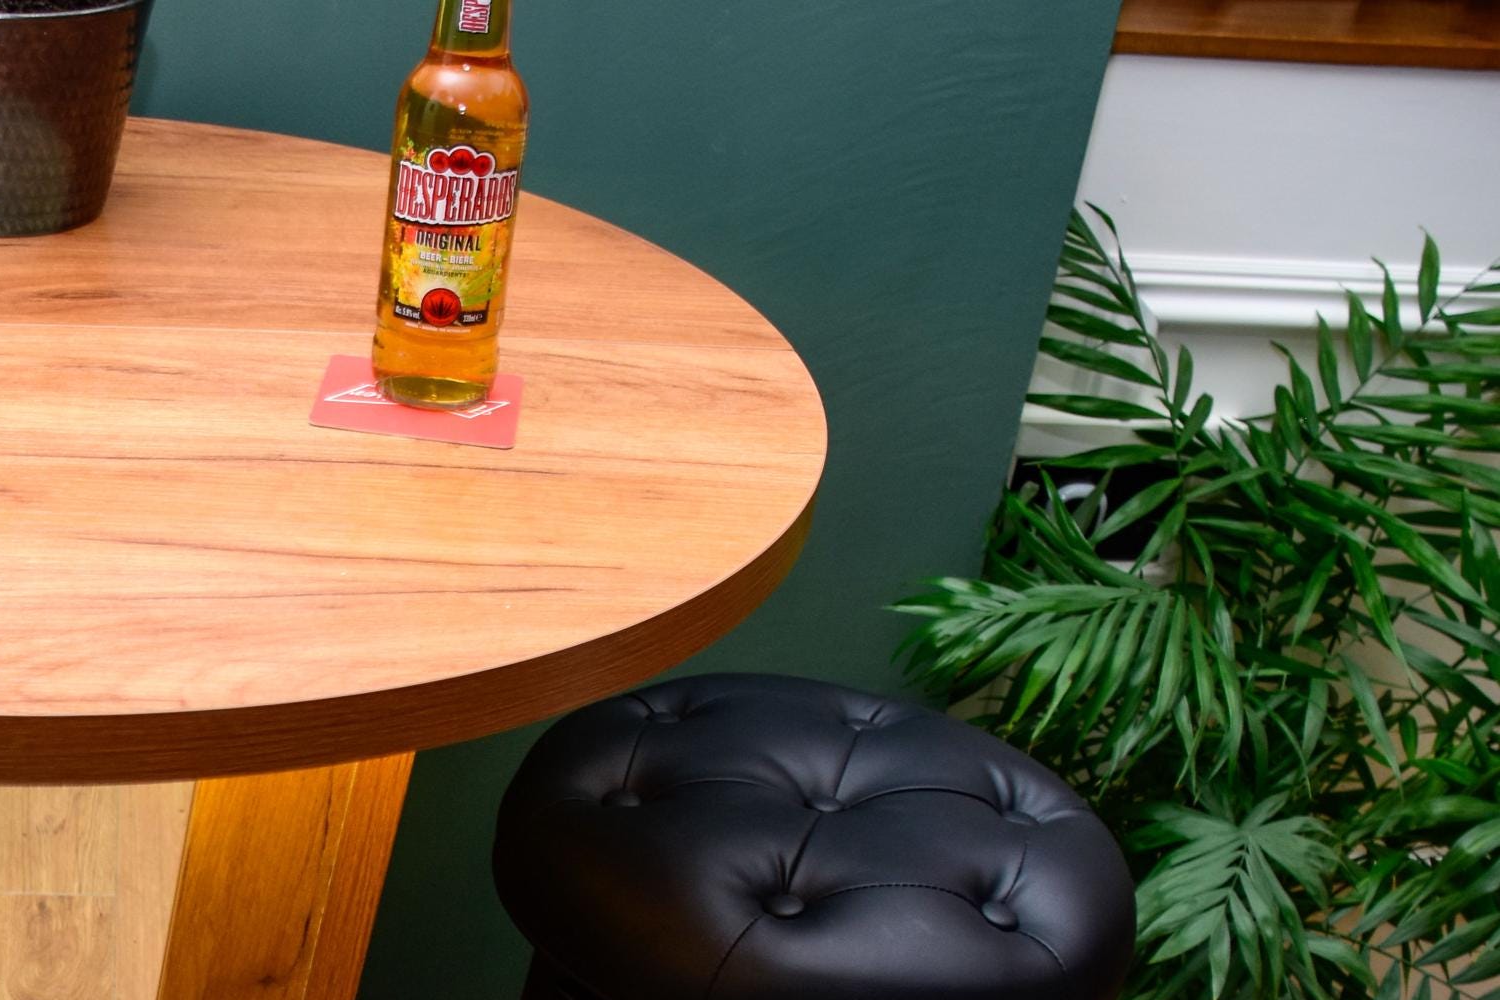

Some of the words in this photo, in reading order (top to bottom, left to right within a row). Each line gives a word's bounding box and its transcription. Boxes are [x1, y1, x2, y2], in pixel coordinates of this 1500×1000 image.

[396, 163, 516, 223] DESPERADOS
[415, 230, 481, 252] ORIGINAL
[420, 251, 442, 262] BEER
